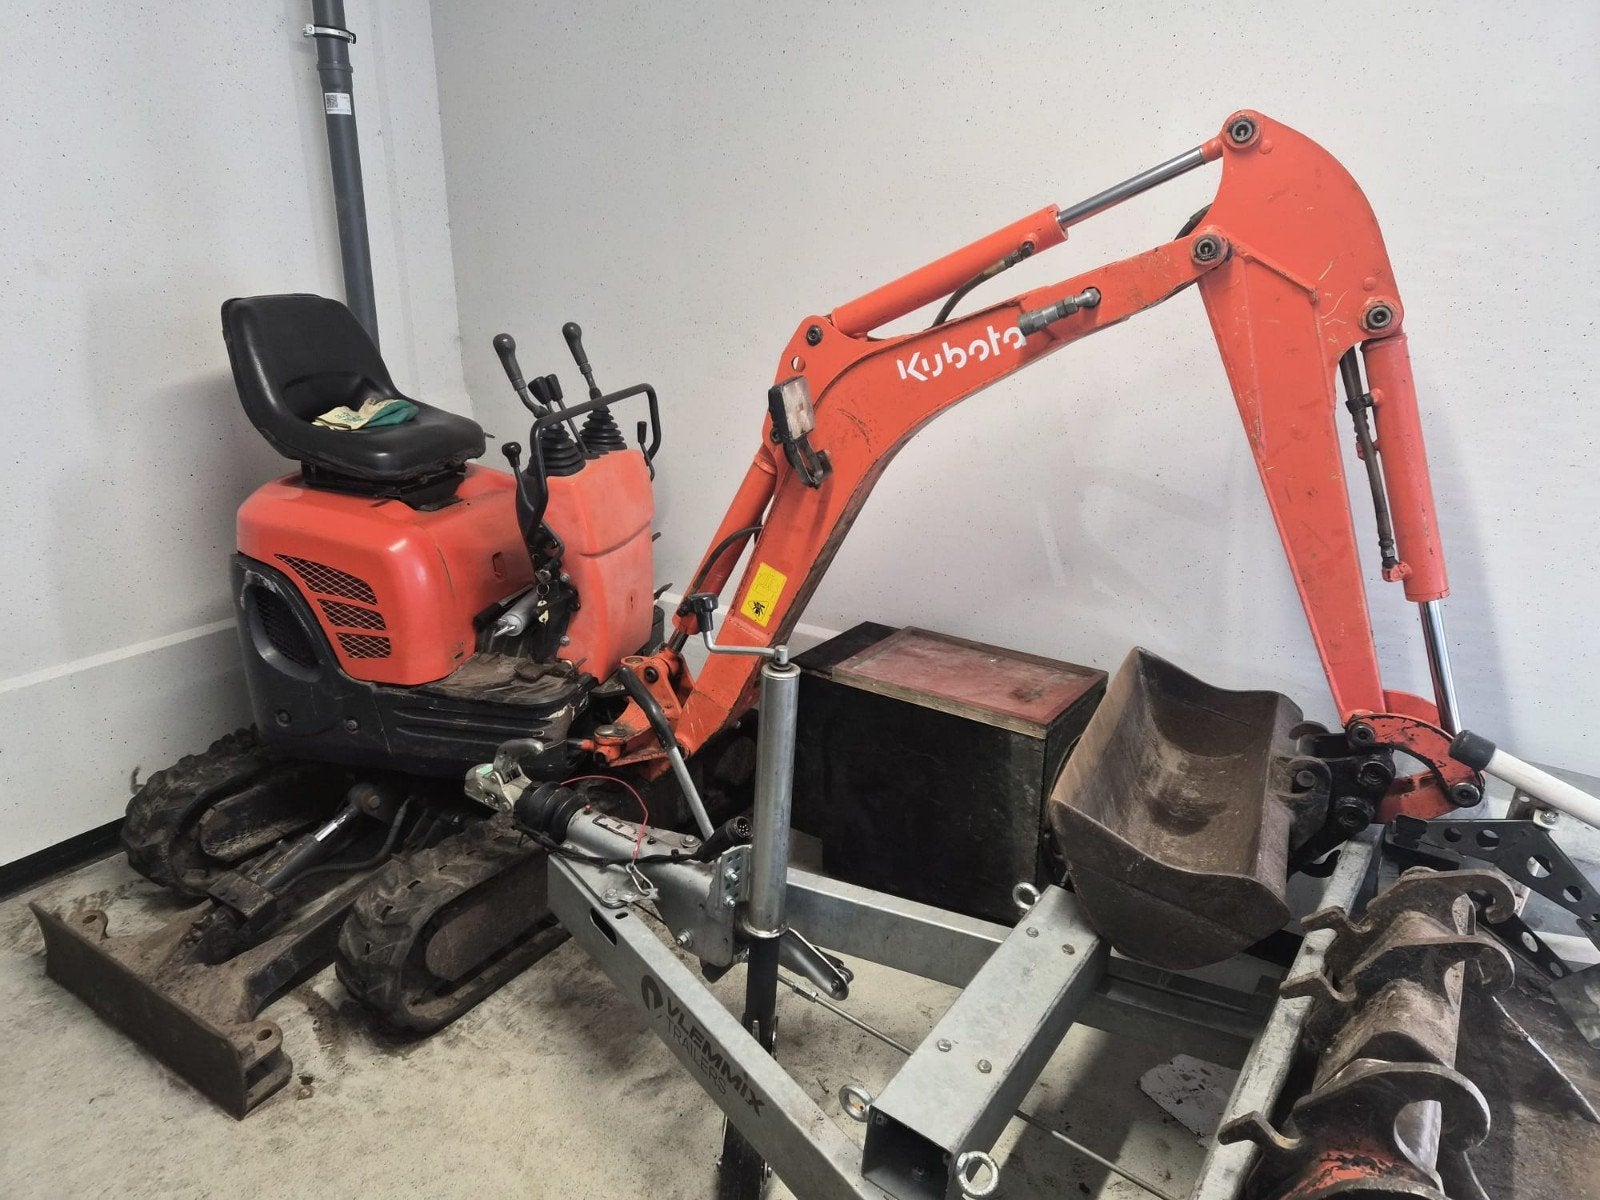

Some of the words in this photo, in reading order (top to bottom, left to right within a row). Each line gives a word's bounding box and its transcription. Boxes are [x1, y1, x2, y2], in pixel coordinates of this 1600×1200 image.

[896, 325, 1027, 381] Kubota
[665, 1014, 727, 1095] TRAILERS
[666, 998, 765, 1117] VLEMMIX
